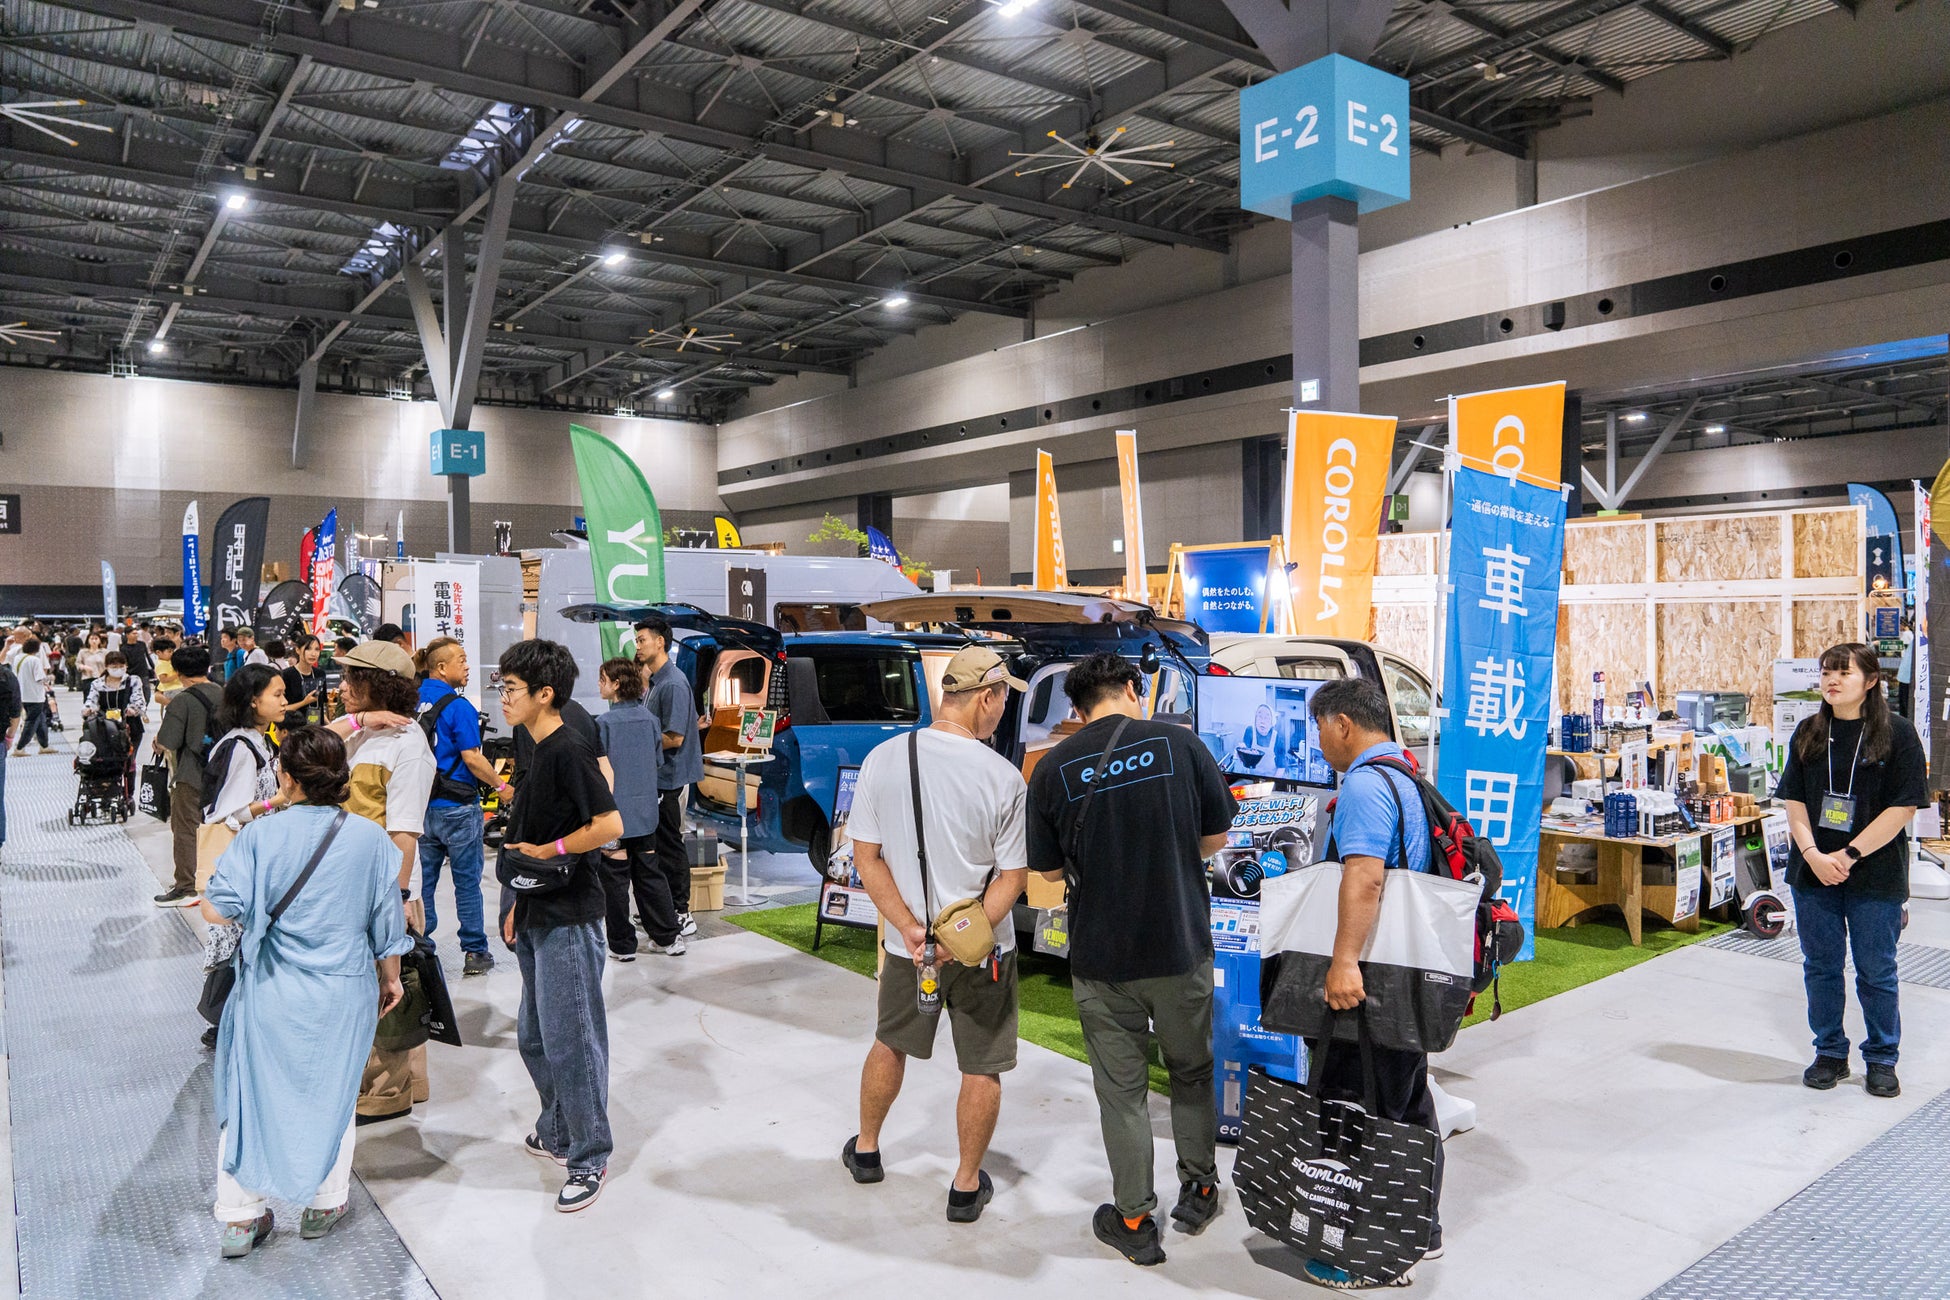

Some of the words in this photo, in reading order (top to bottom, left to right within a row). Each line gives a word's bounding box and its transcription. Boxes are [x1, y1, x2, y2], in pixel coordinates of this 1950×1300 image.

[1255, 105, 1319, 163] E-2
[1347, 100, 1399, 156] E-2
[451, 443, 477, 459] E-1
[1396, 502, 1408, 513] D-1
[1316, 437, 1357, 621] COROLLA
[231, 524, 246, 601] BRADLEY
[1202, 586, 1254, 597] 偶然をたのしむ。
[1202, 600, 1254, 611] 自然とつながる。
[1080, 751, 1154, 783] eoco
[515, 875, 538, 887] NIKE
[1043, 929, 1067, 945] VENDOR
[920, 992, 938, 1002] BLACK
[1291, 1157, 1363, 1192] SOOMLOOM
[1313, 1184, 1336, 1194] 2025
[1295, 1186, 1309, 1199] MAKE
[1309, 1193, 1334, 1207] CAMPING
[1335, 1202, 1350, 1211] EASY
